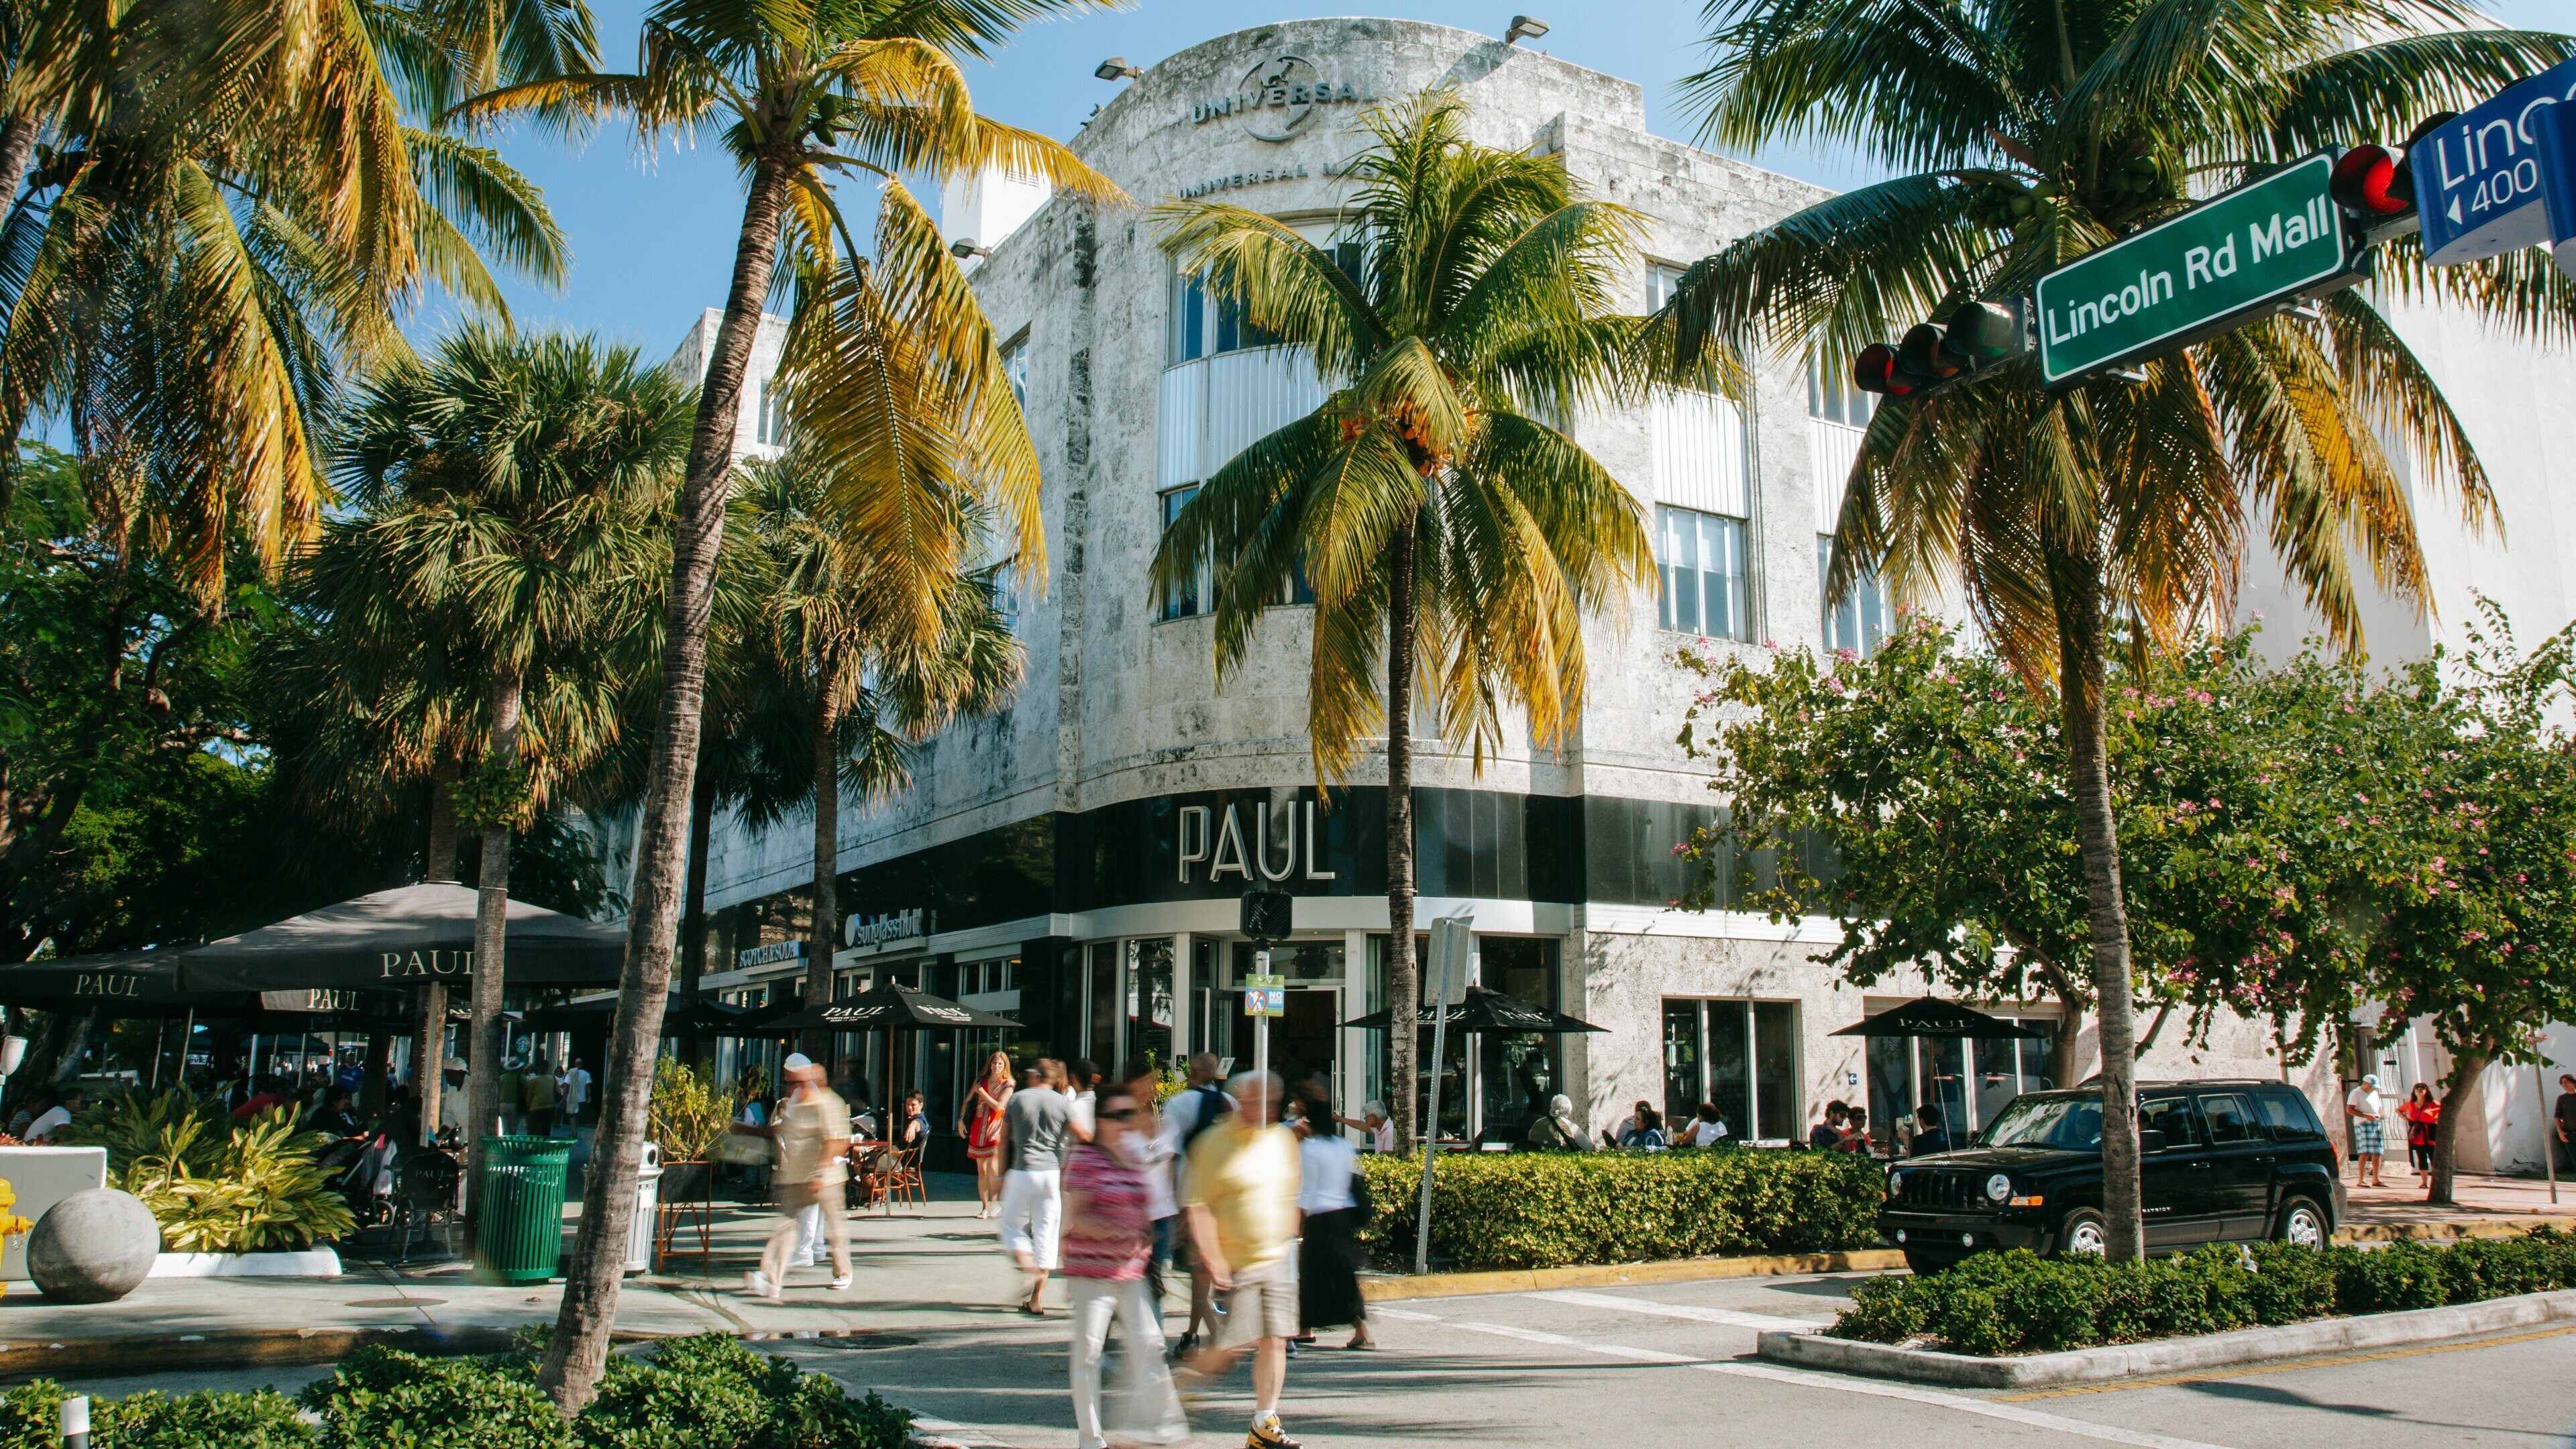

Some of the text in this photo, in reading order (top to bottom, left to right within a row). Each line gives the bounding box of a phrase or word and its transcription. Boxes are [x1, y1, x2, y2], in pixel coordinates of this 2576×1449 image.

[1190, 83, 1379, 124] UNIVERSAL
[2437, 81, 2576, 191] Linc
[1179, 164, 1309, 198] UNIVERSAL
[2471, 158, 2538, 213] 400
[2048, 193, 2330, 346] Lincoln Rd Mall
[1179, 800, 1336, 884] PAUL
[74, 974, 141, 996] PAUL
[307, 988, 360, 1011] PAUL
[821, 1006, 885, 1016] PAUL
[1898, 1018, 1974, 1028] PAUL
